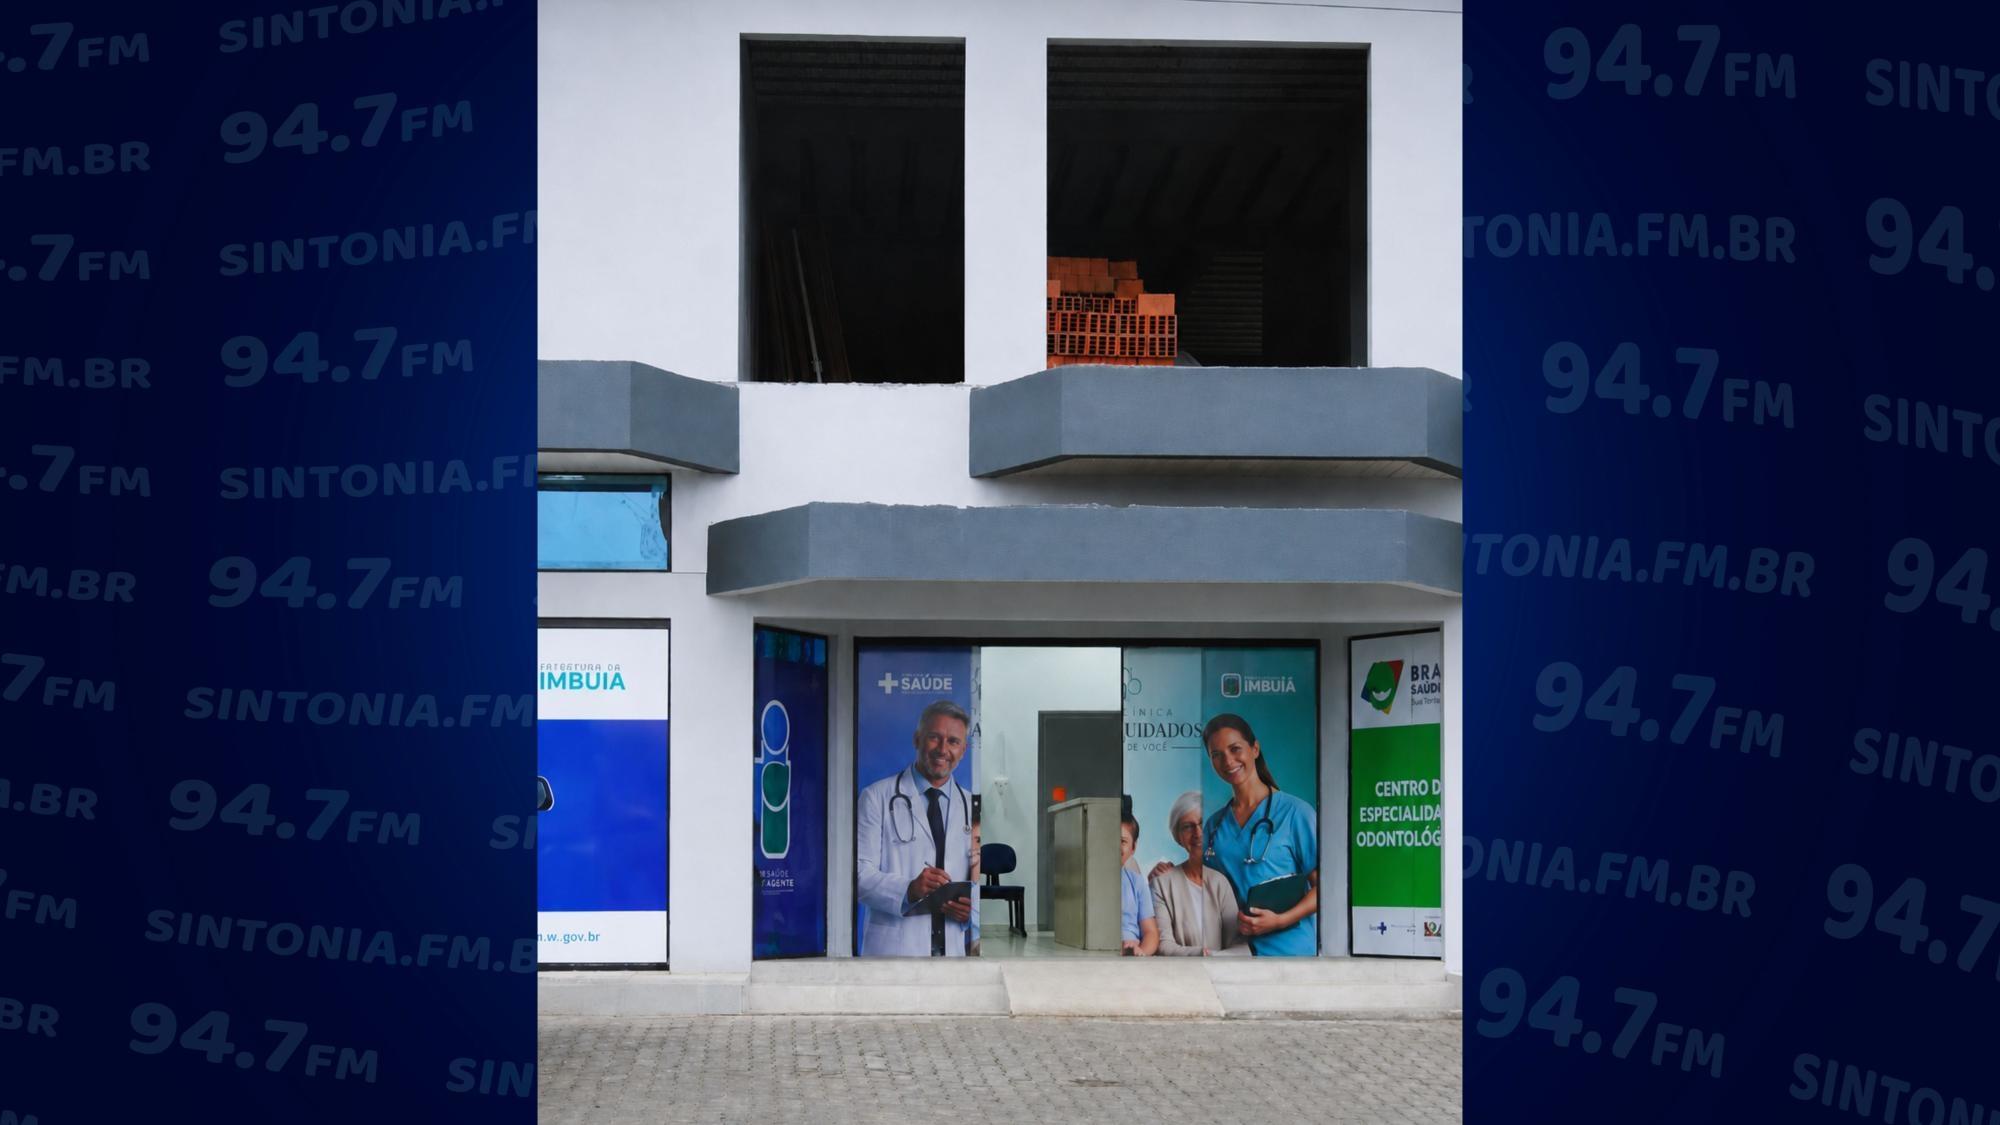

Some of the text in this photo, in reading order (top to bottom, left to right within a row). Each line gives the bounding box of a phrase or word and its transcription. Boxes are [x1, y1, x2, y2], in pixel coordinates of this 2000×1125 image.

[540, 672, 626, 690] IMBUIA
[1411, 663, 1441, 681] BRA
[901, 673, 953, 690] SAÚDE
[1375, 780, 1429, 797] CENTRO
[1360, 804, 1441, 822] ESPECIALIDA
